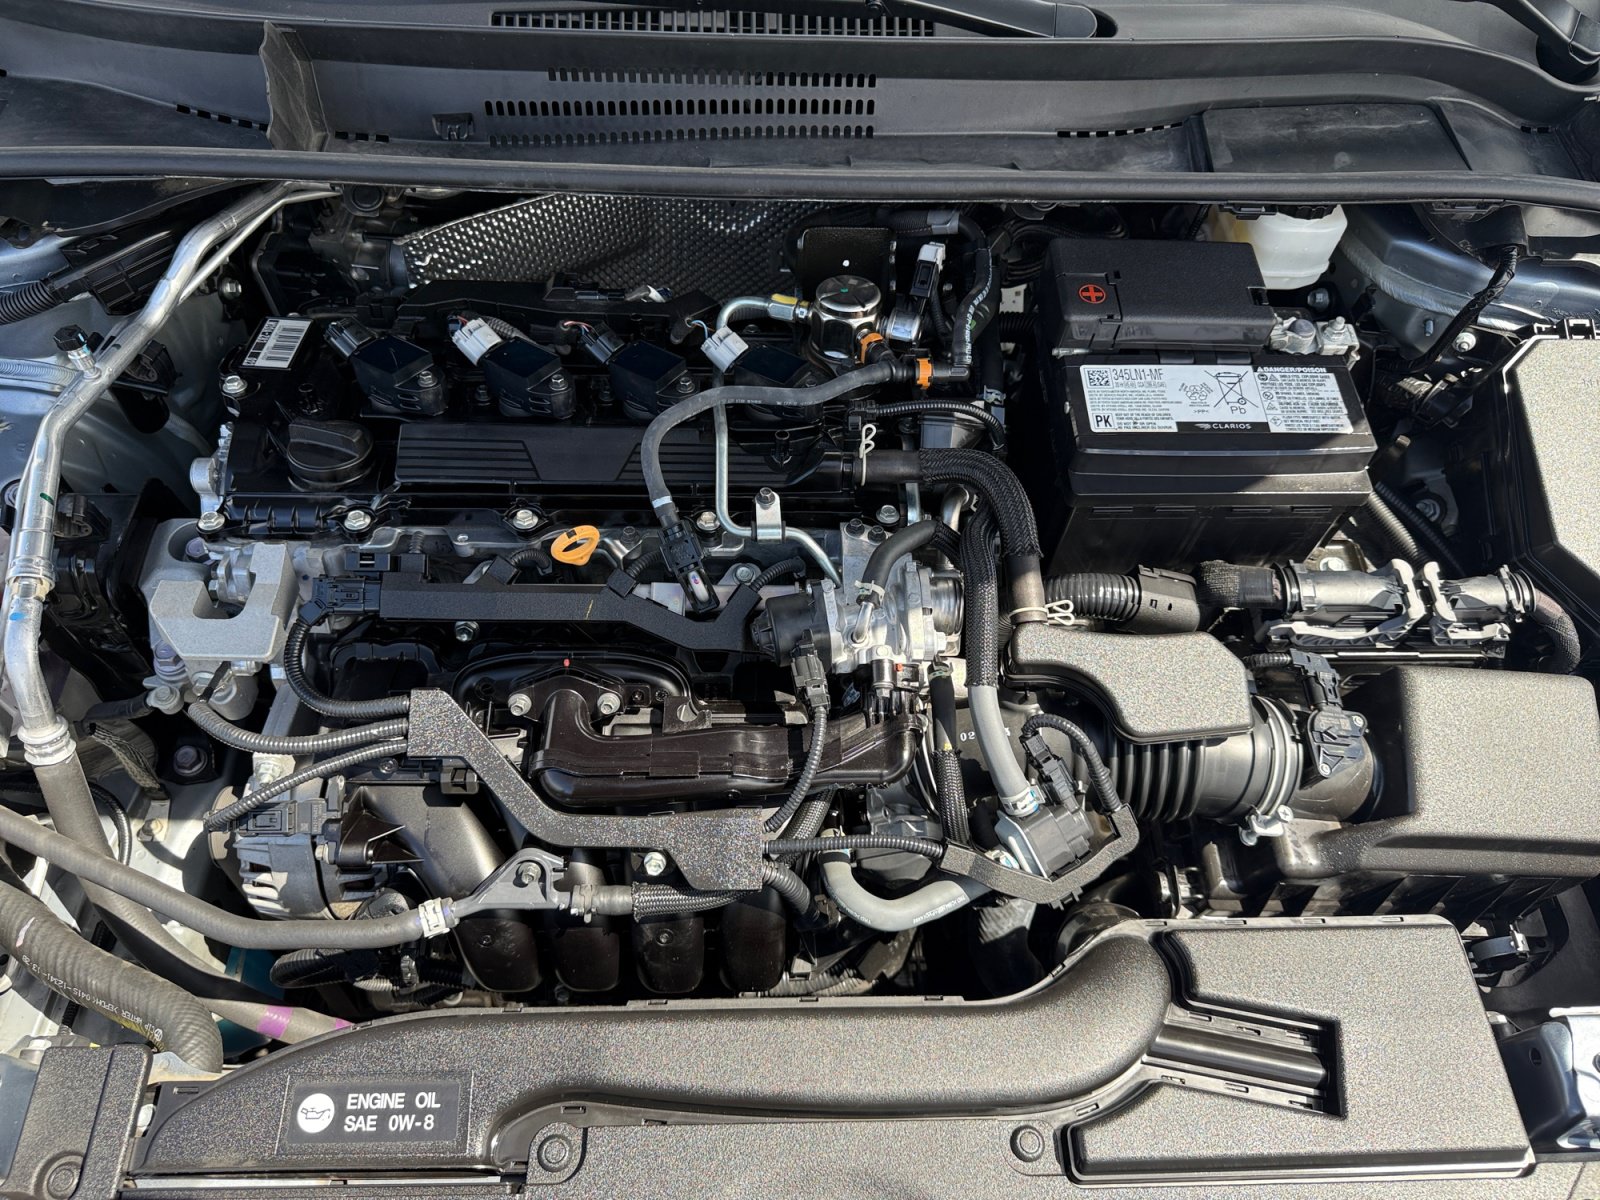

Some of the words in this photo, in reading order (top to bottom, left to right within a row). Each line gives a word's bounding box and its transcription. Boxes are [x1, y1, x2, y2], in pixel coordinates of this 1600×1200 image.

[1112, 368, 1164, 381] 345LN1-MF
[1230, 405, 1247, 415] Pb
[1095, 414, 1113, 428] PK
[346, 1092, 406, 1110] ENGINE
[415, 1091, 441, 1109] OIL
[343, 1114, 378, 1132] SAE
[388, 1114, 435, 1132] 0W-8
